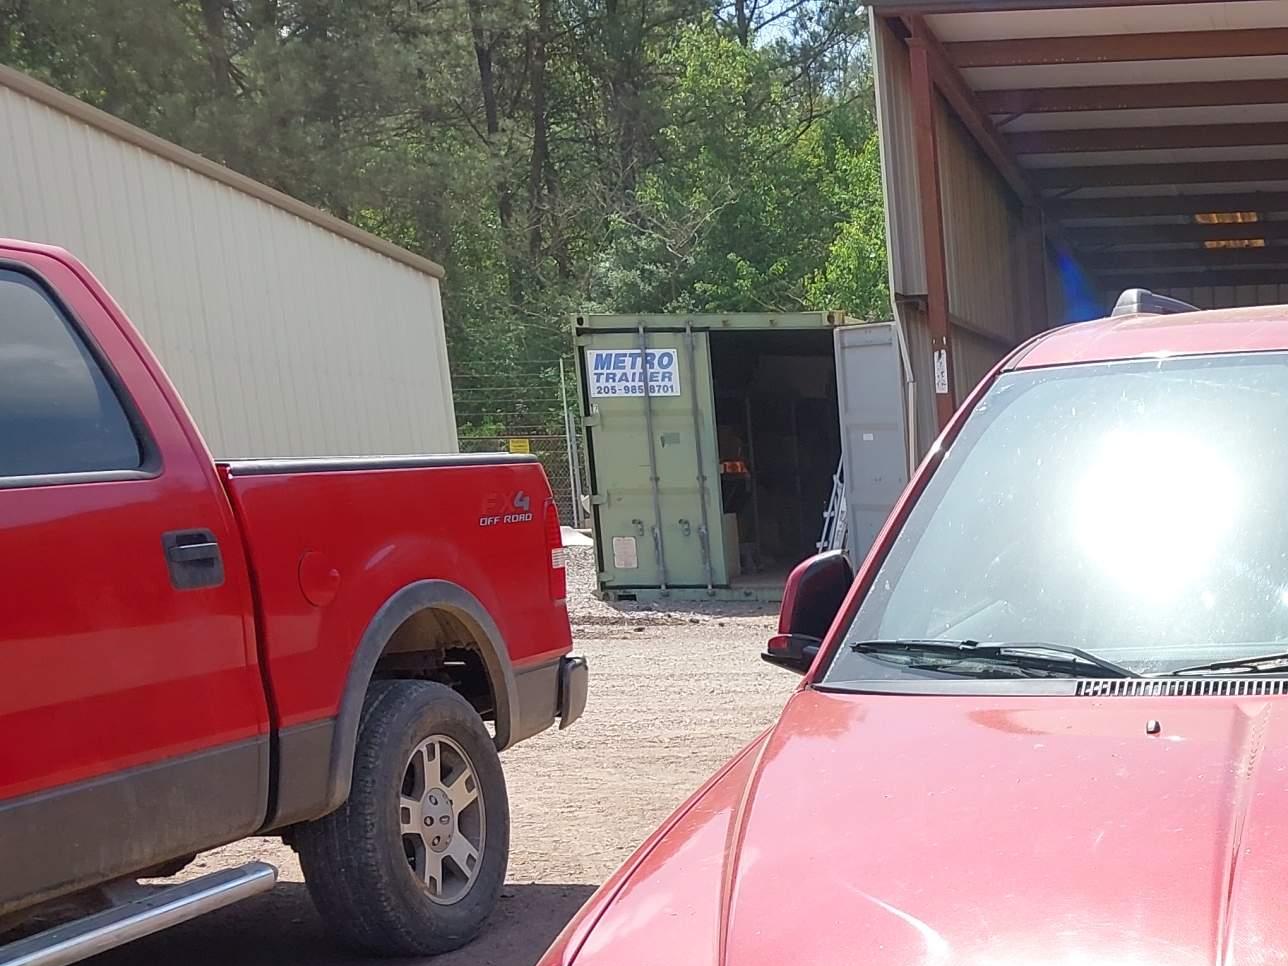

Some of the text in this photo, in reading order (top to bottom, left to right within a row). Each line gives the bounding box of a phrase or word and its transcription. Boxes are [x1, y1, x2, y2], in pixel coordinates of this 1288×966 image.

[593, 352, 674, 370] METRO
[596, 384, 674, 395] 205-9858701
[479, 512, 533, 526] OFF ROAD
